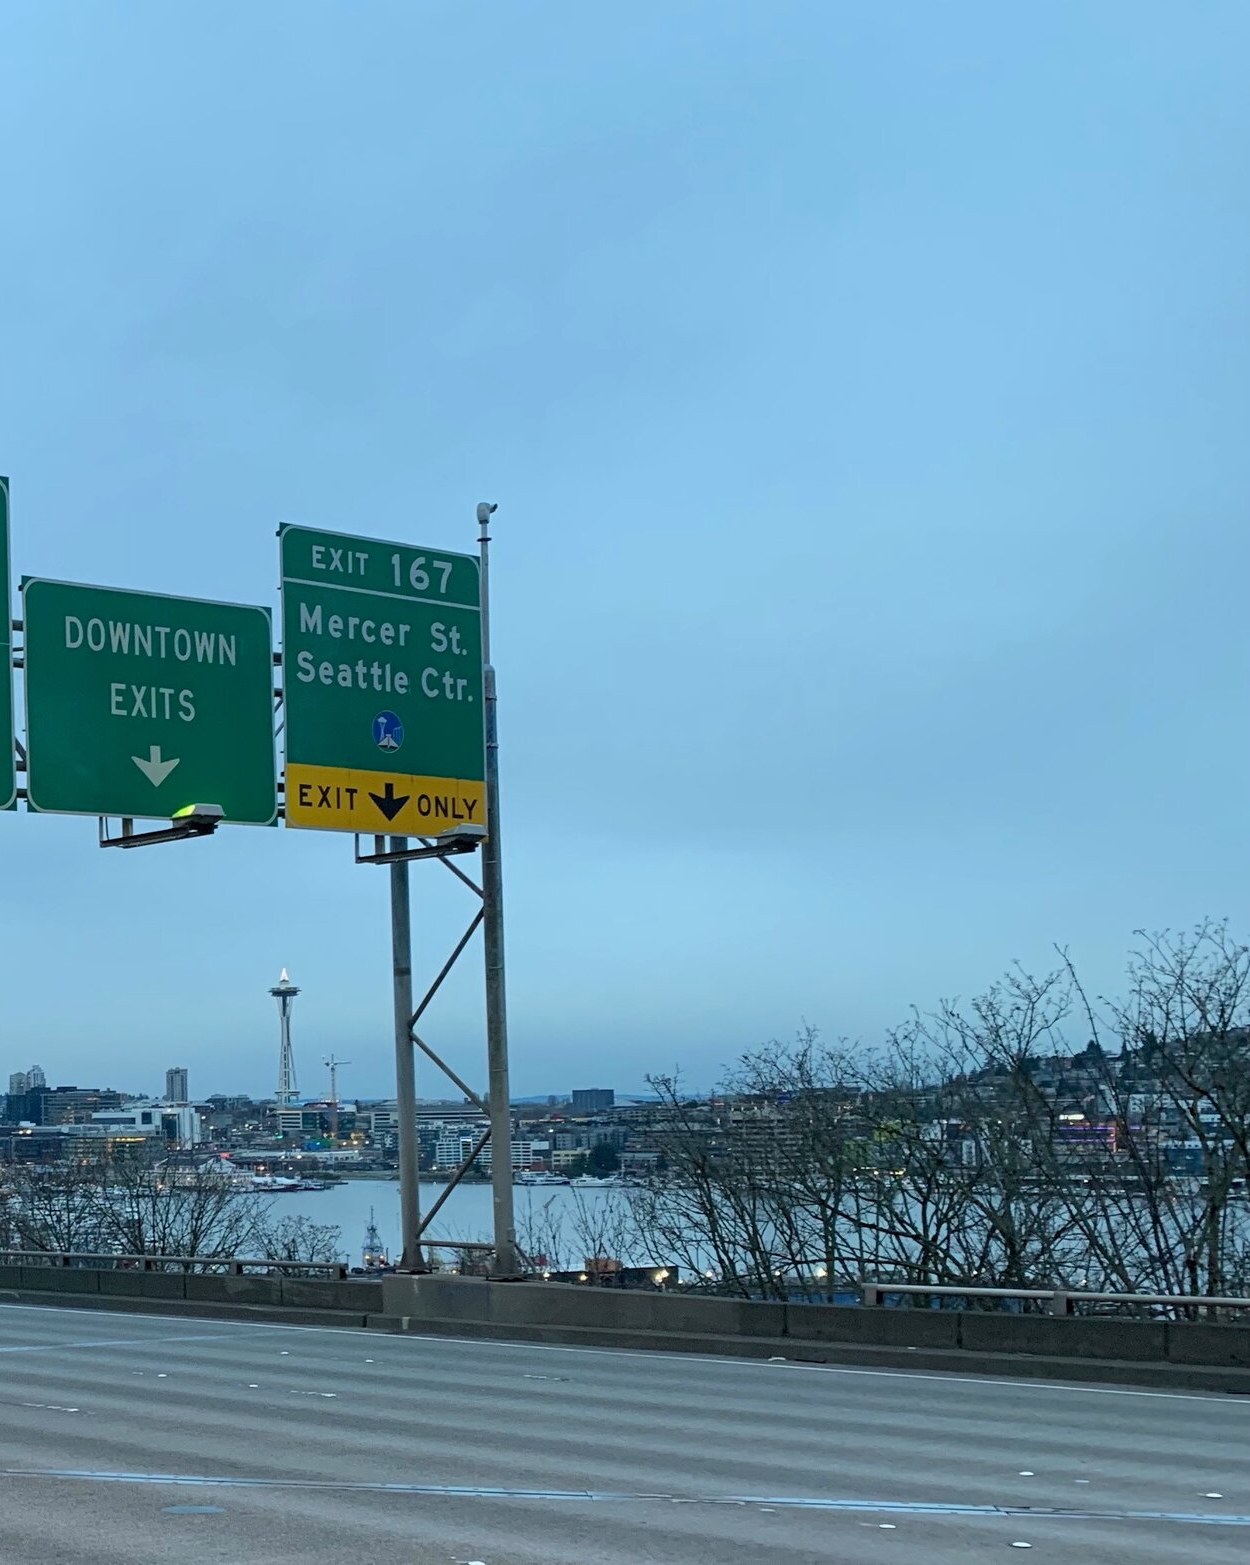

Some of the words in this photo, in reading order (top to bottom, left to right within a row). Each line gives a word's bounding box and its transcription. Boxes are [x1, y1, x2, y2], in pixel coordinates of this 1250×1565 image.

[312, 545, 369, 575] EXIT
[391, 553, 453, 594] 167
[65, 616, 236, 666] DOWNTOWN
[300, 602, 411, 646] Mercer
[430, 622, 468, 656] St.
[297, 651, 408, 695] Seattle
[421, 667, 474, 702] Ctr.
[110, 683, 196, 722] EXITS
[299, 784, 358, 811] EXIT
[417, 794, 478, 821] ONLY
